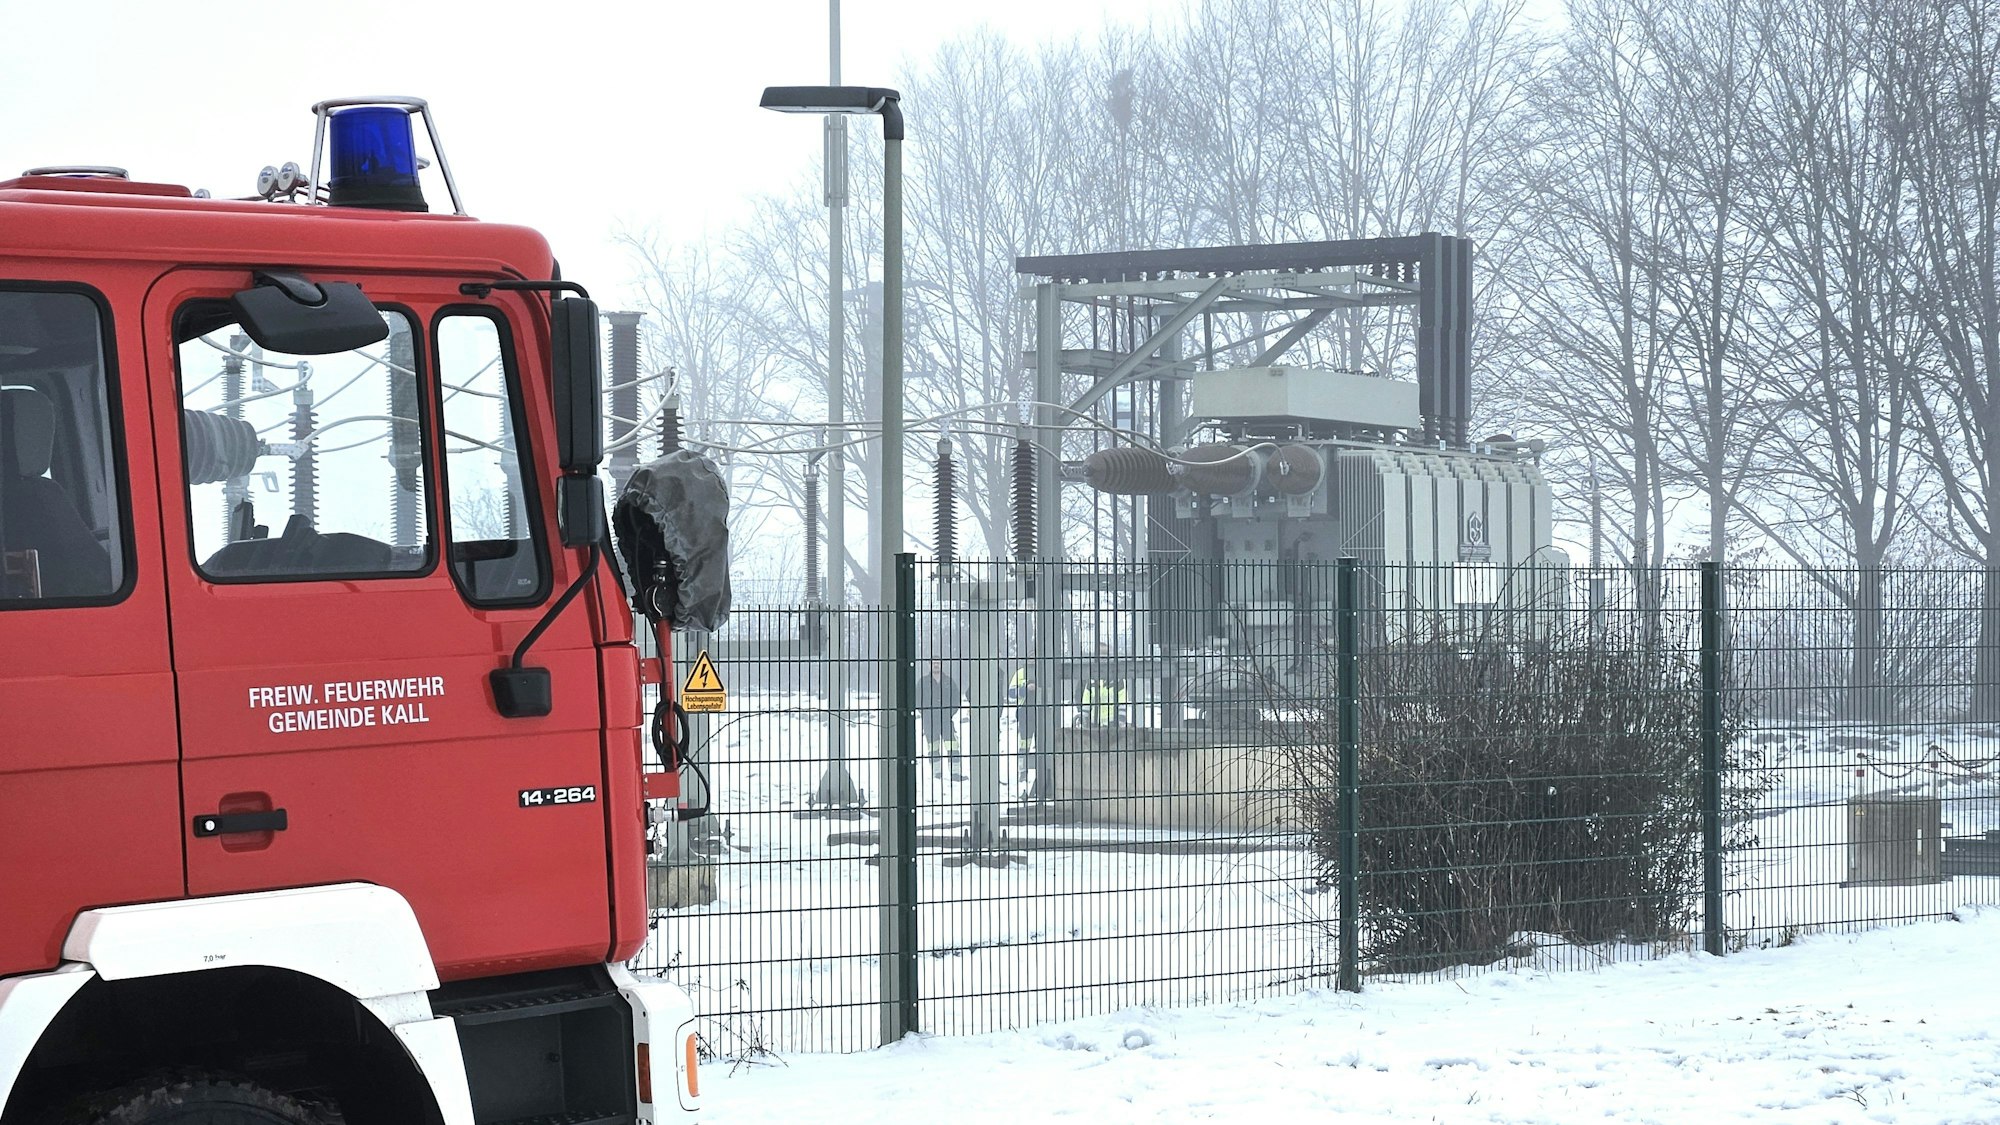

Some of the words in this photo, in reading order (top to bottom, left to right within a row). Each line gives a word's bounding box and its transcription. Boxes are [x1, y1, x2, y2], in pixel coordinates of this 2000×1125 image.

[248, 684, 318, 708] FREIW.
[324, 676, 445, 703] FEUERWEHR
[685, 695, 723, 703] Hochspannung
[268, 706, 376, 733] GEMEINDE
[381, 703, 429, 725] KALL
